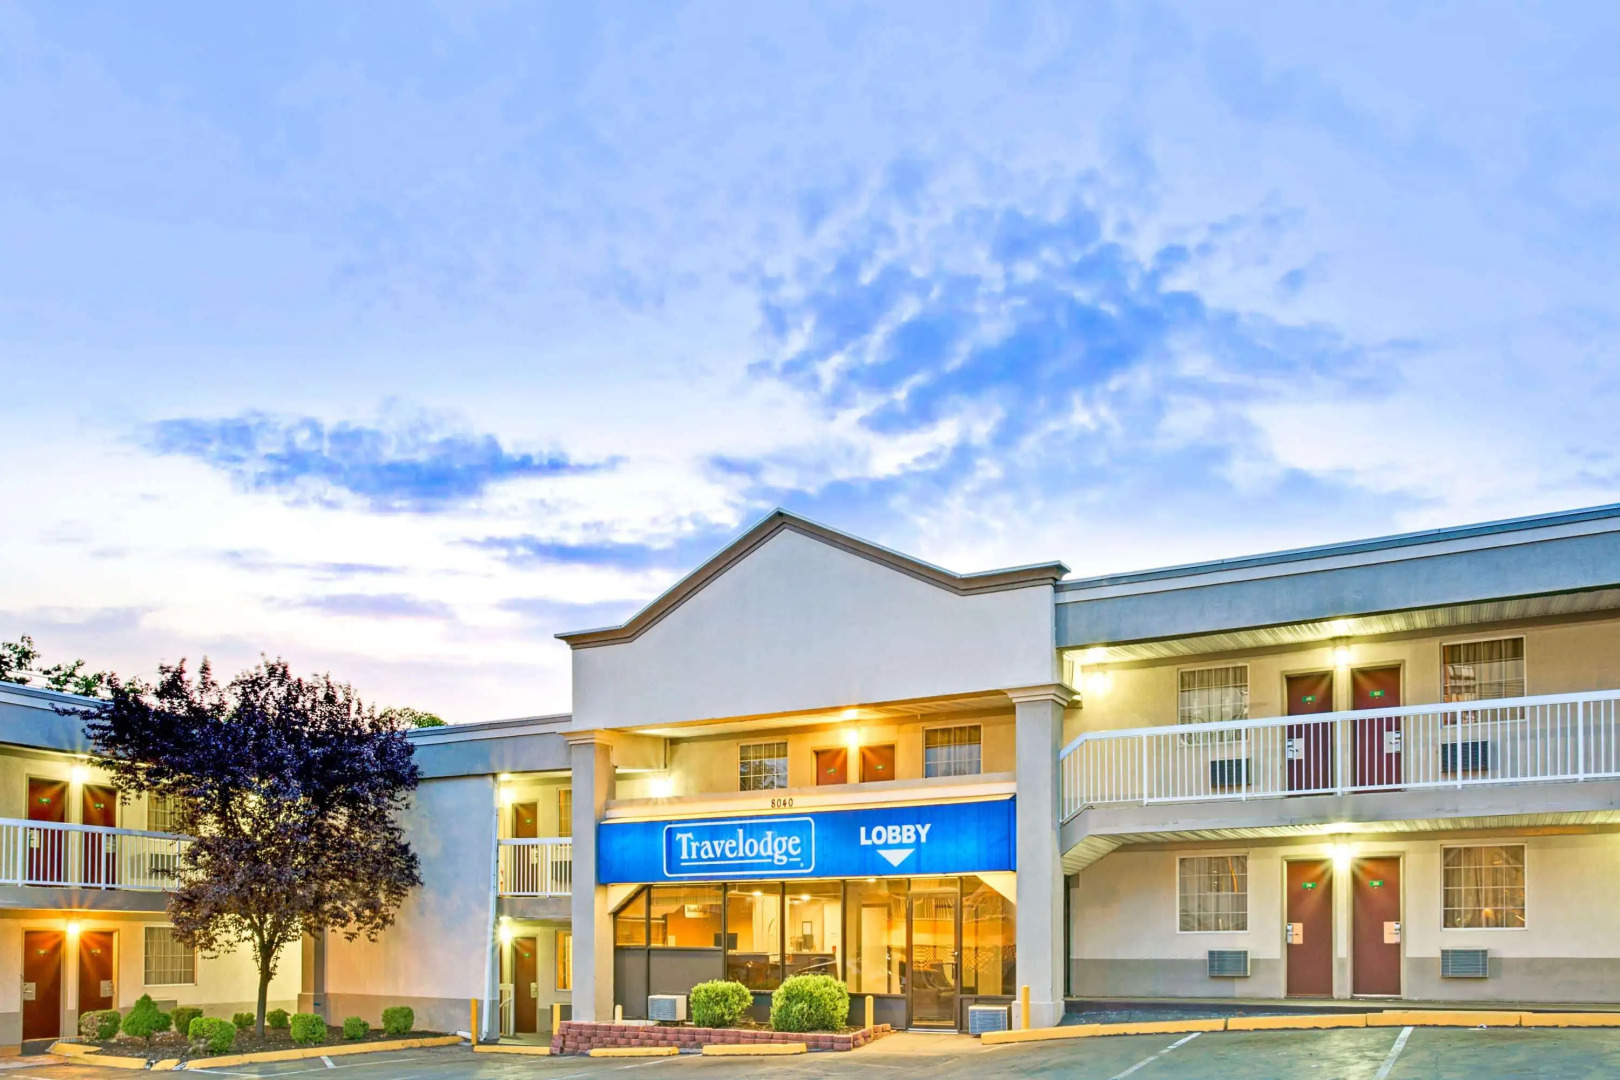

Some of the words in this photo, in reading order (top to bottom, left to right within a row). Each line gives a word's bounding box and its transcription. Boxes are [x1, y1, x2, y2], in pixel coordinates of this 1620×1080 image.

[771, 798, 793, 808] 8040
[860, 824, 931, 845] LOBBY
[676, 829, 801, 865] Travelodge
